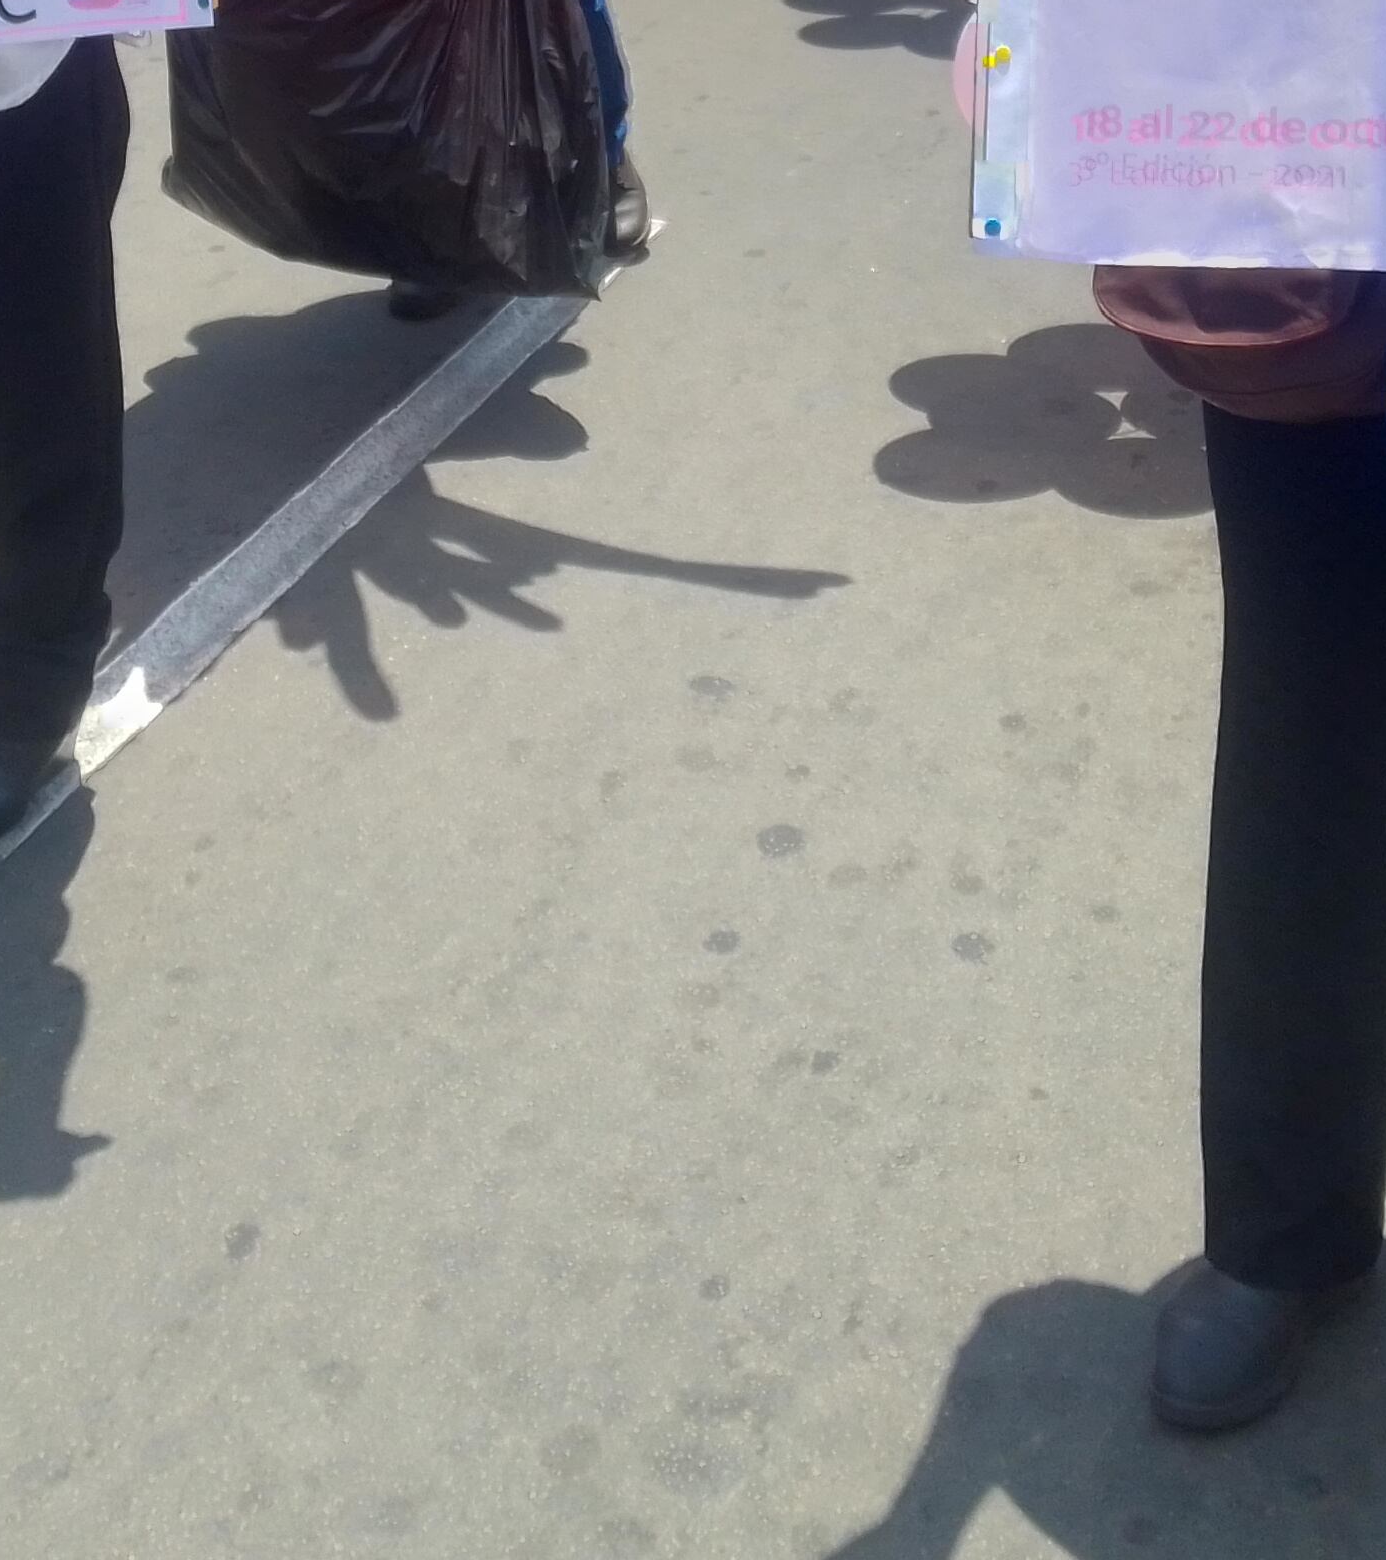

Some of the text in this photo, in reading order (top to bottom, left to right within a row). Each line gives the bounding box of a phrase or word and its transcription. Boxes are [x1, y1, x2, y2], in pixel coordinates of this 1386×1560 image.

[1071, 104, 1124, 145] 18
[1127, 104, 1175, 144] al
[1176, 110, 1237, 149] 22
[1238, 106, 1307, 150] de
